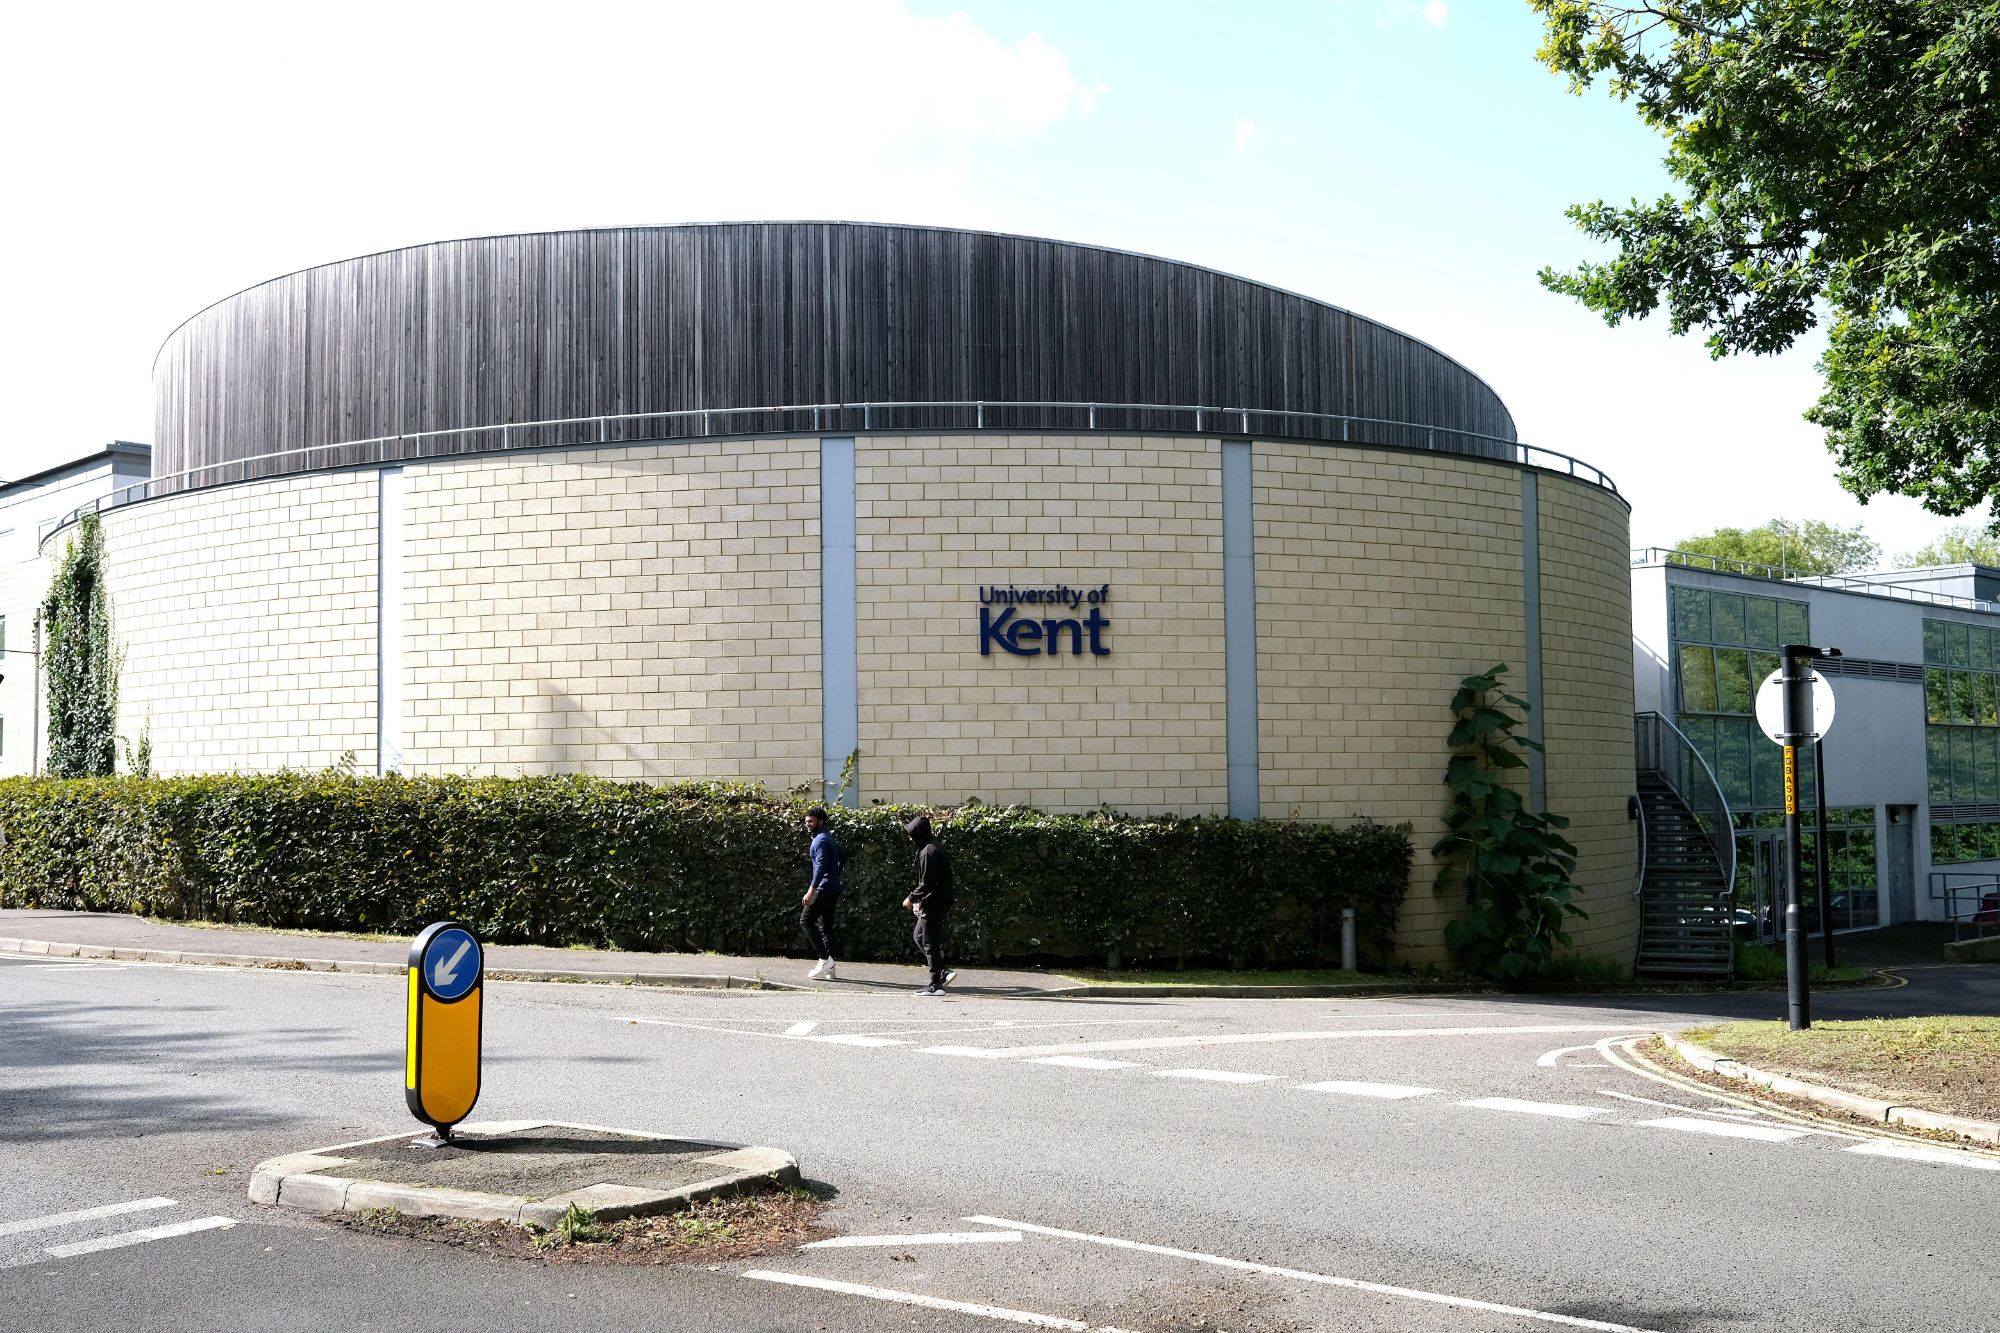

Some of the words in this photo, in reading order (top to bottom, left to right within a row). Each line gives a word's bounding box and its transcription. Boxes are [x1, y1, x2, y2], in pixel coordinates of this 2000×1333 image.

[979, 584, 1083, 609] University
[1087, 584, 1110, 604] of
[979, 607, 1111, 656] Kent
